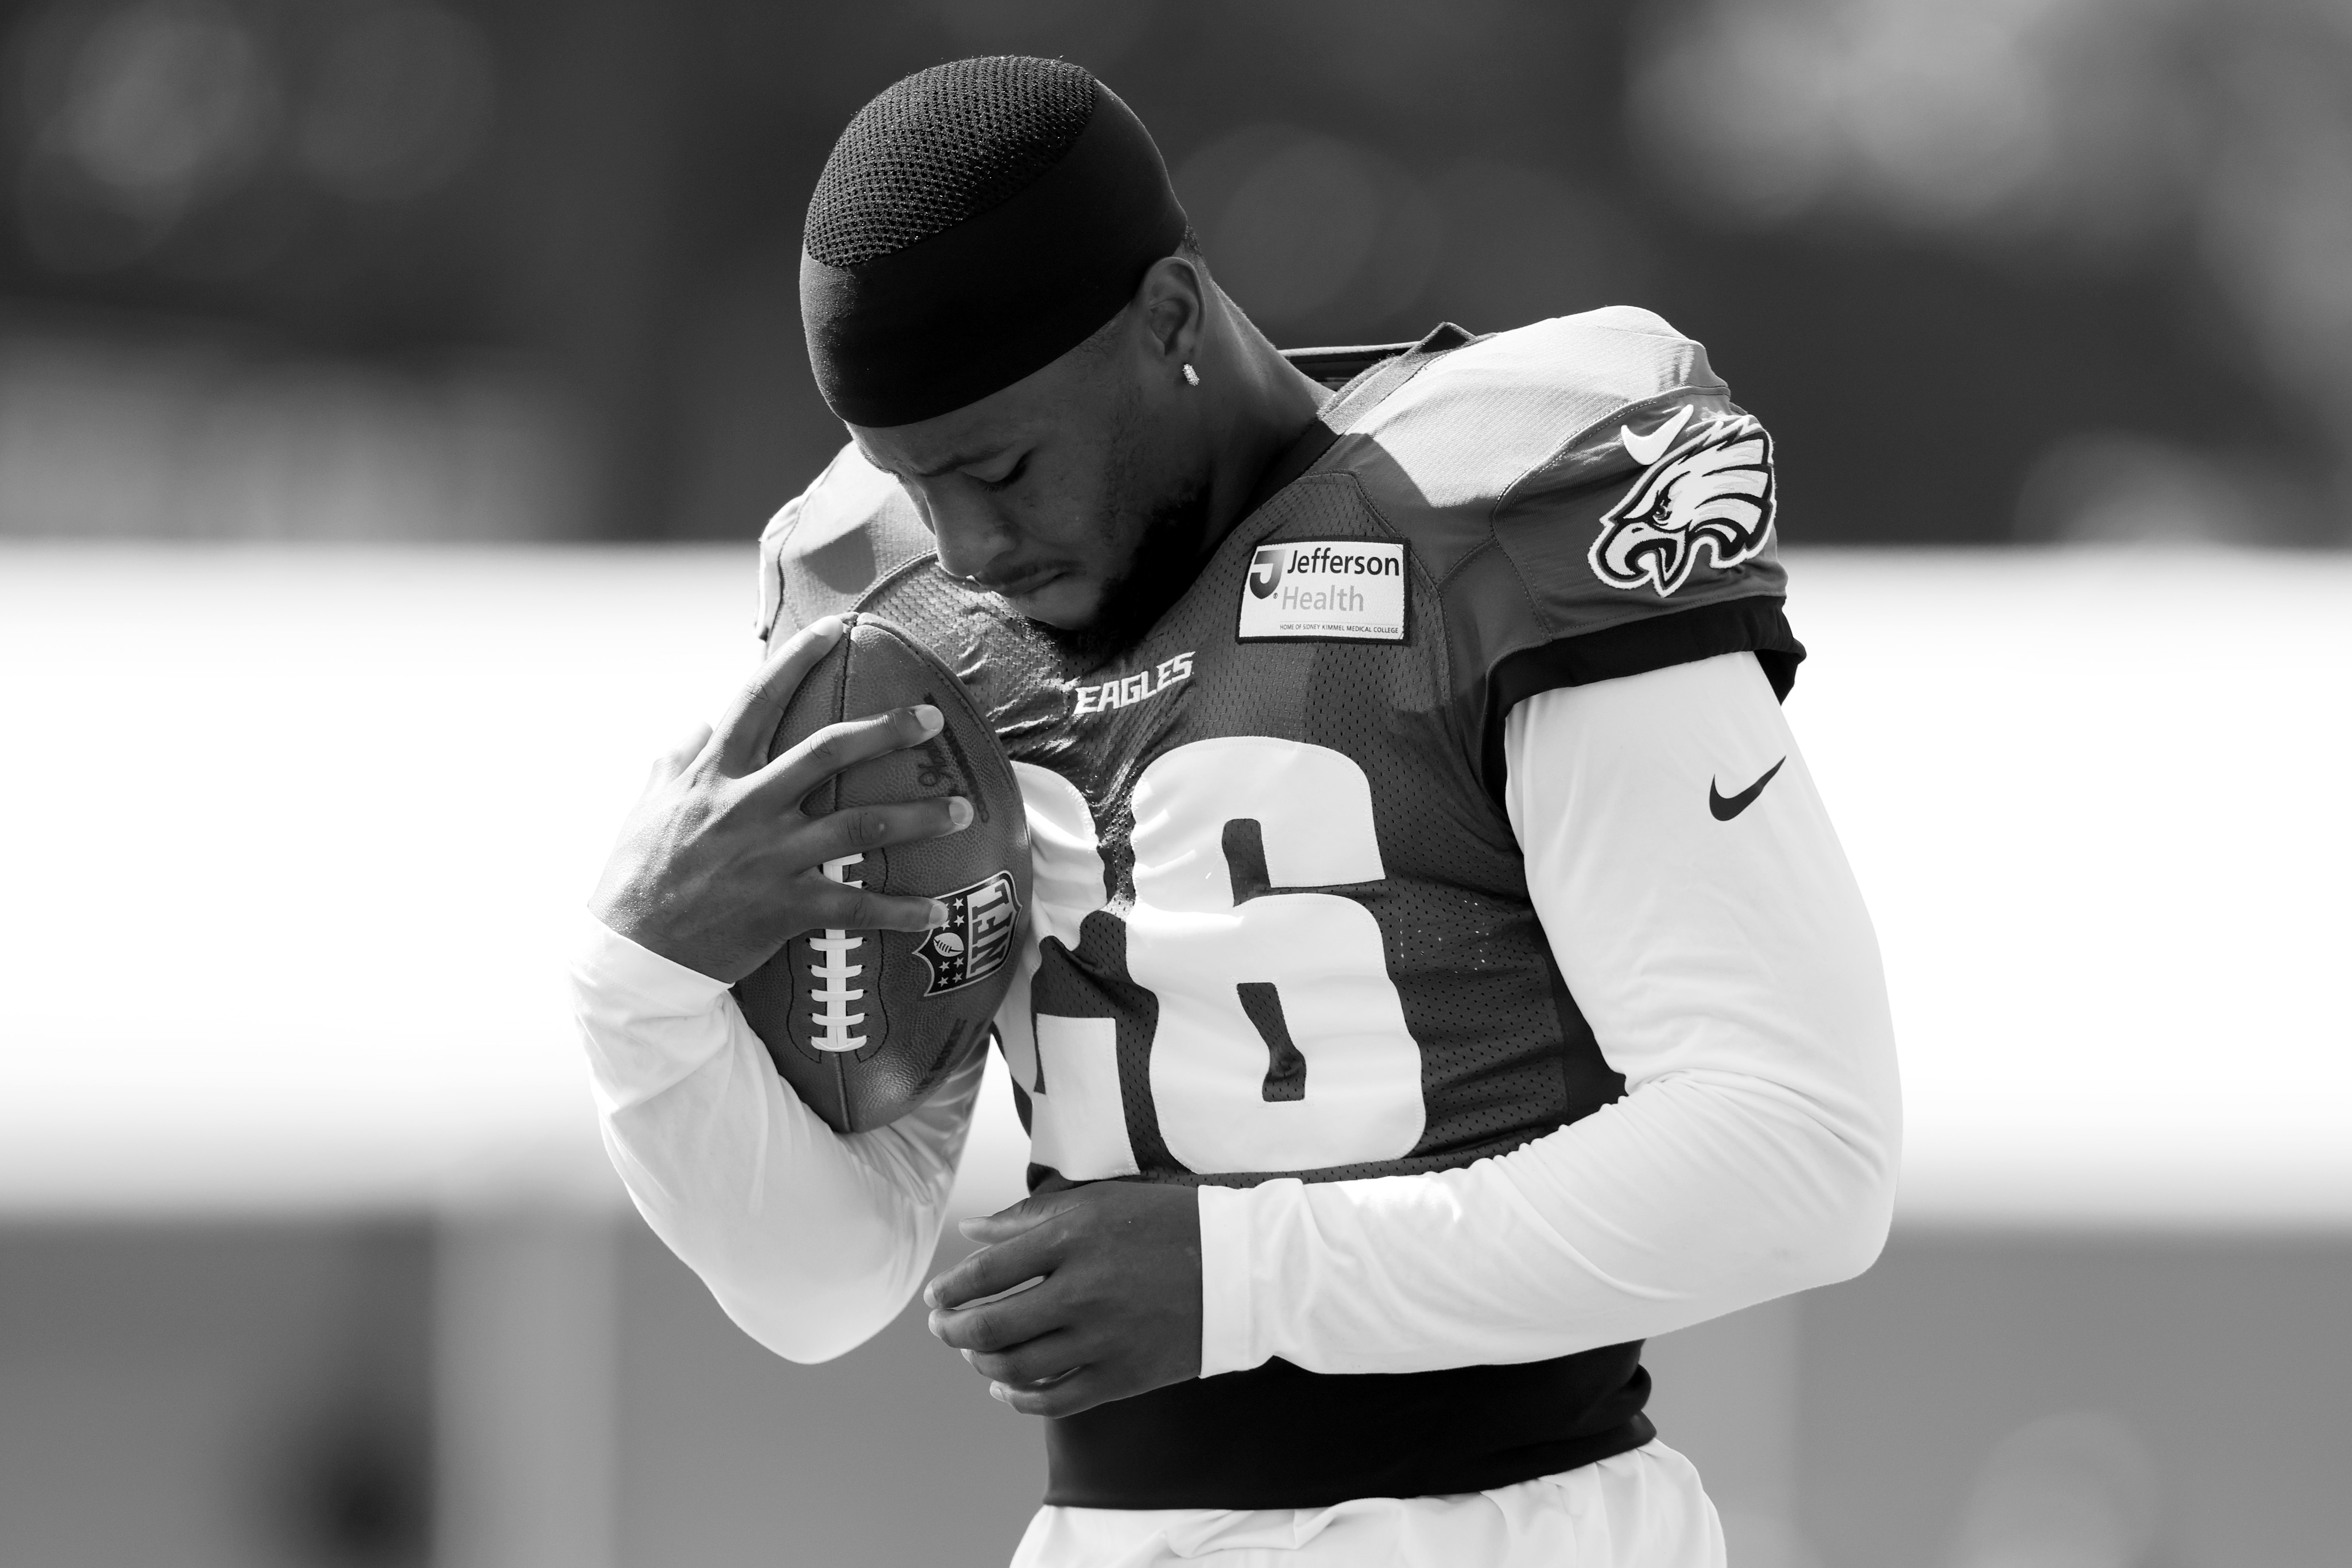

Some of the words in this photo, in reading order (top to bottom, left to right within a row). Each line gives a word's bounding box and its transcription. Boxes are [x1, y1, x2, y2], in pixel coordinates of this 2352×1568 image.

[1287, 547, 1399, 576] Jefferson
[1282, 585, 1364, 612] Health
[1073, 650, 1196, 714] EAGLES
[971, 883, 1013, 974] NFL
[994, 736, 1426, 1181] 26
